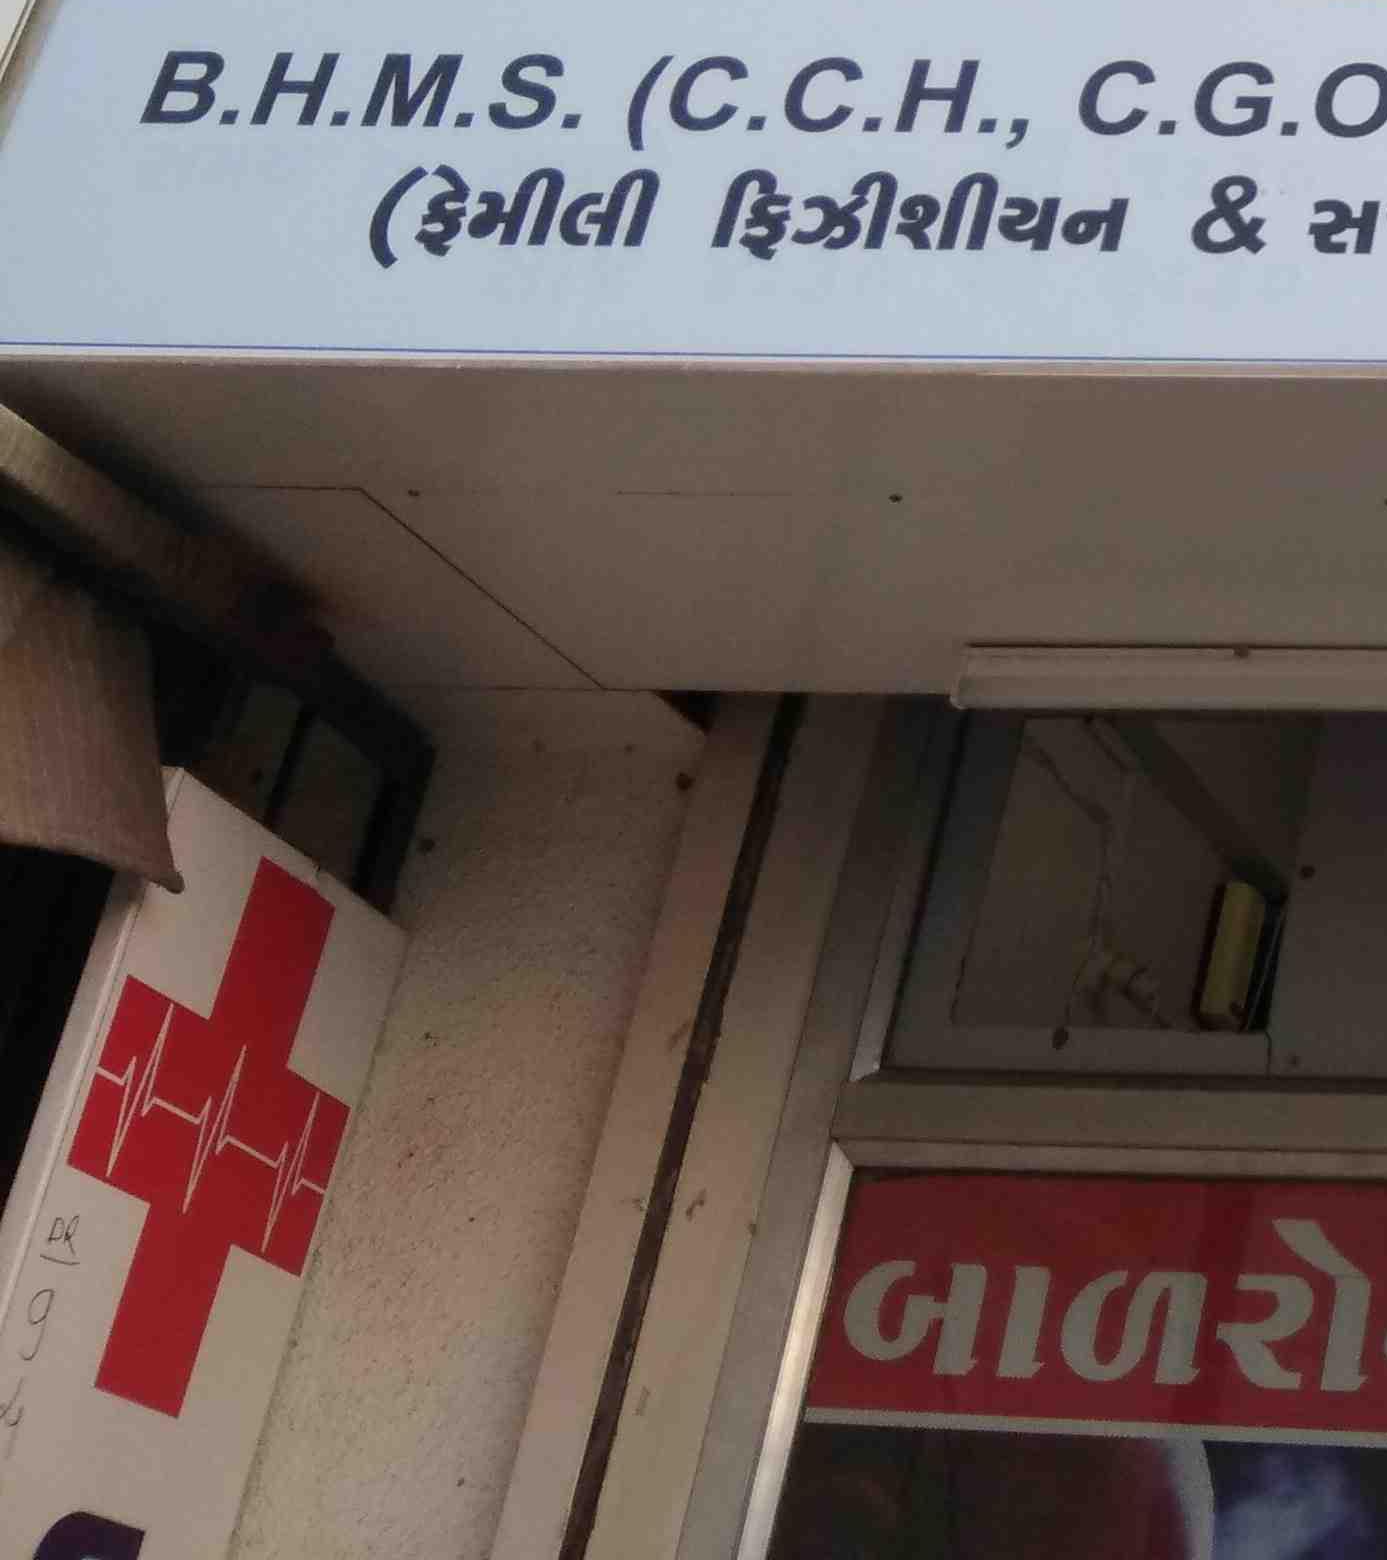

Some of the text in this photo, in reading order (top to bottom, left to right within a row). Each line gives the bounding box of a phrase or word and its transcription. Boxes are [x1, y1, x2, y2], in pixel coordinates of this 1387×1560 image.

[139, 50, 582, 130] B.H.M.S.
[627, 55, 1030, 152] (C.C.H.,
[369, 163, 660, 270] (ફેમીલી
[1191, 175, 1267, 255] &
